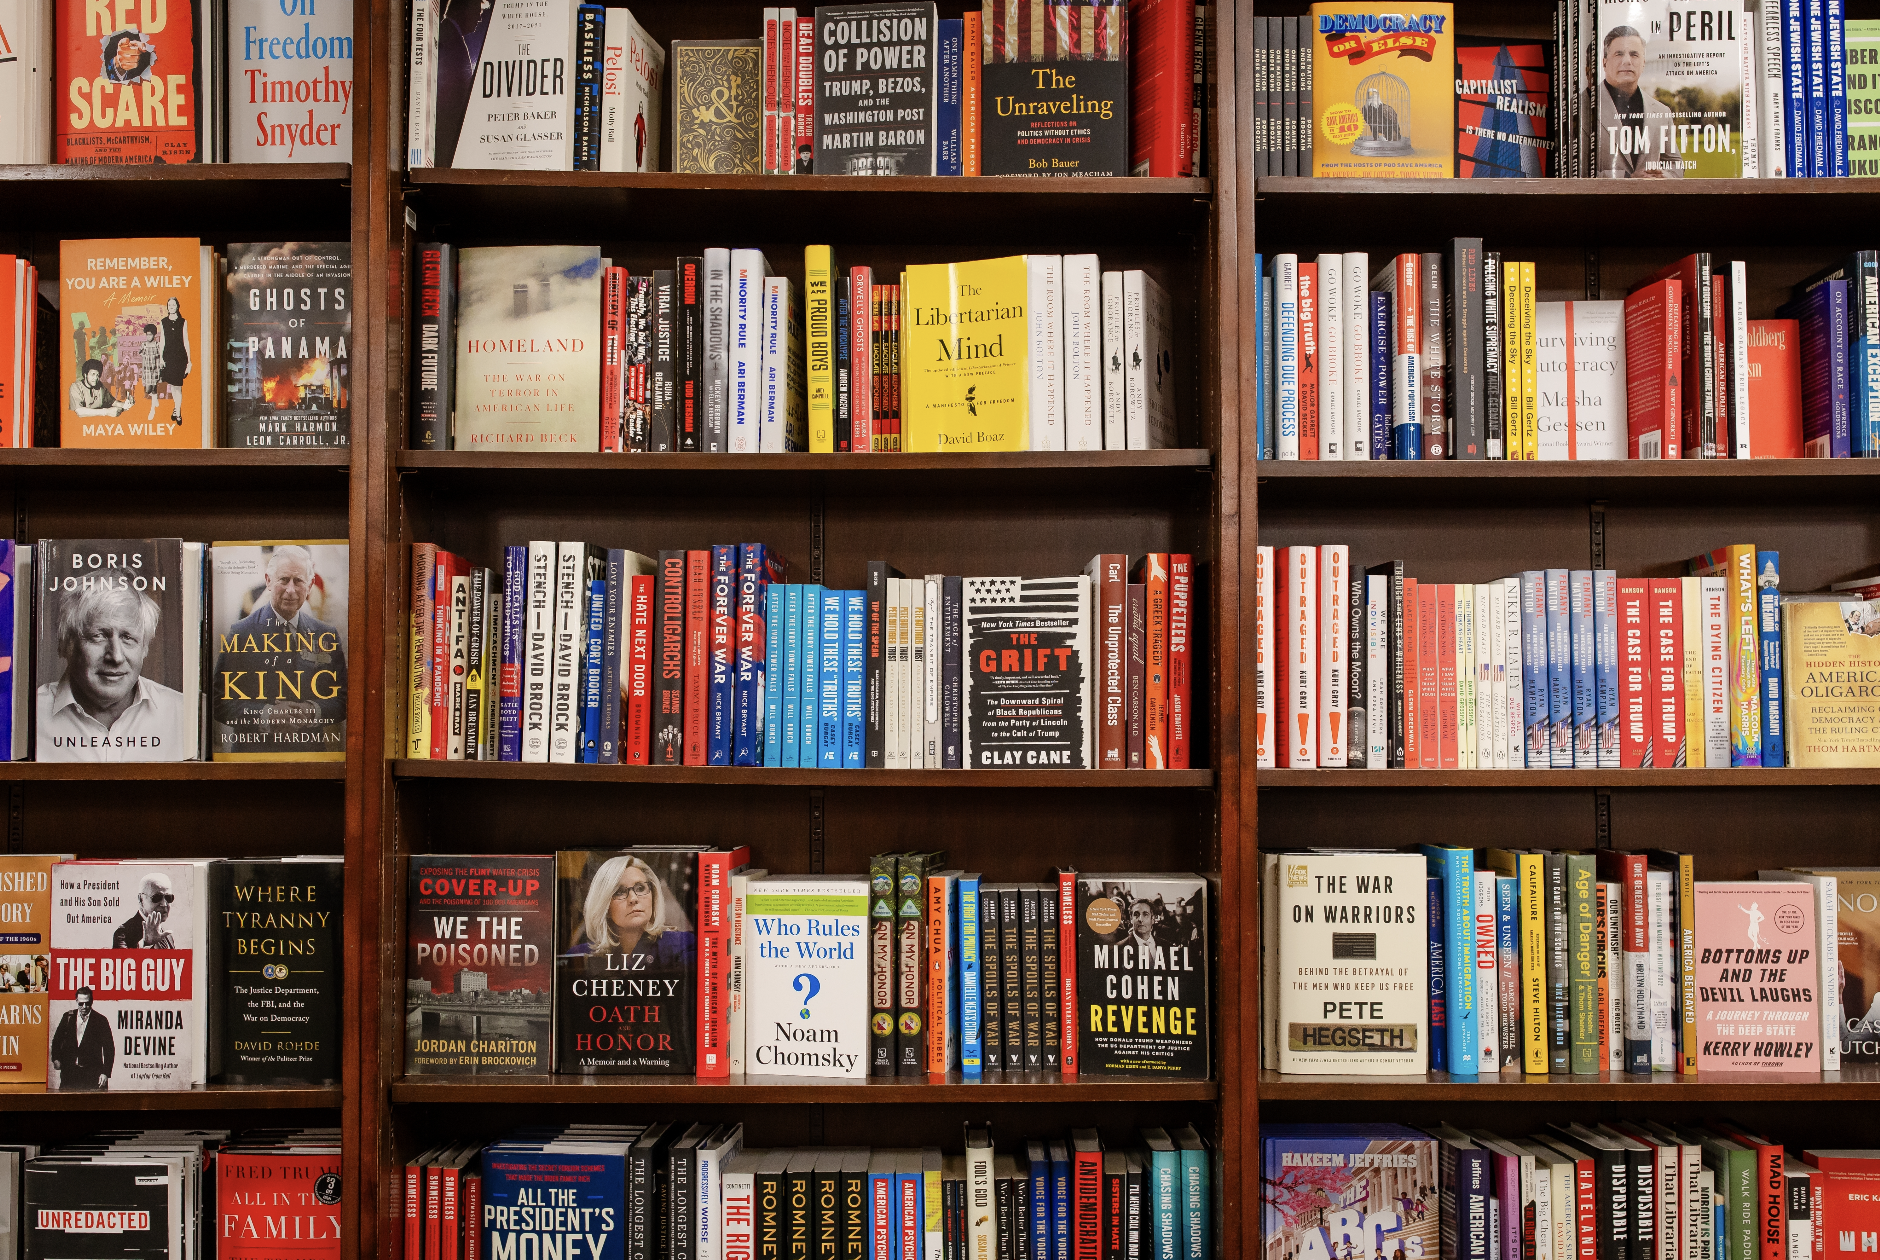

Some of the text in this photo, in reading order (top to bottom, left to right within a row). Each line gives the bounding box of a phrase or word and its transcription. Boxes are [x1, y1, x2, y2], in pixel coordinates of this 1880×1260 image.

[823, 18, 927, 45] COLLISION
[1319, 13, 1446, 34] DEMOCRACY
[1669, 10, 1736, 42] PERIL
[244, 23, 353, 60] Freedom
[518, 43, 530, 55] THE
[583, 13, 595, 79] BASELESS
[824, 45, 926, 72] OF POWER
[482, 58, 564, 98] DIVIDER
[605, 46, 622, 95] Pelosi
[1032, 68, 1076, 89] The
[245, 66, 353, 114] Timothy
[824, 77, 926, 97] TRUMP, BEZOS,
[1455, 79, 1518, 95] CAPITALIST
[69, 75, 188, 129] SCARE
[995, 95, 1113, 119] Unraveling
[1496, 96, 1546, 118] REALISM
[487, 111, 558, 122] PETER BAKER
[824, 108, 924, 125] WASHINGTON POST
[257, 110, 341, 157] Snyder
[480, 132, 564, 144] SUSAN GLASSER
[822, 129, 925, 150] MARTIN BARON
[1474, 128, 1495, 140] THERE
[1497, 132, 1506, 142] NO
[1508, 134, 1554, 150] ALTERNATIVE?
[1608, 124, 1736, 155] TOM FITTON,
[1028, 159, 1079, 169] Bob Bauer
[1645, 160, 1696, 170] JUDICIAL WATCH
[87, 256, 172, 271] REMEMBER,
[66, 275, 192, 290] YOU ARE A WILEY
[957, 284, 982, 296] The
[249, 288, 345, 311] GHOSTS
[289, 318, 305, 328] OF
[658, 285, 670, 362] VIRAL JUSTICE
[915, 302, 1023, 326] Libertarian
[249, 336, 347, 359] PANAMA
[468, 338, 584, 354] HOMELAND
[737, 269, 747, 424] MINORITY RULE ARI BERMAN
[936, 334, 1004, 361] Mind
[1282, 303, 1295, 437] DEFENDING DUE PROCESS
[475, 404, 540, 412] AMERICAN
[82, 423, 175, 437] MAYA WILEY
[259, 421, 337, 432] MARK HARMON
[938, 432, 1004, 445] David Boaz
[73, 554, 143, 568] BORIS
[49, 576, 166, 591] JOHNSON
[219, 632, 339, 653] MAKING
[634, 595, 648, 696] HATE NEXT DOOR
[1010, 634, 1037, 644] THE
[979, 648, 1072, 672] GRIFT
[1108, 604, 1121, 726] The Unprotected Class
[1627, 600, 1643, 743] THE CASE FOR TRUMP
[220, 669, 342, 700] KING
[996, 708, 1062, 716] Black Republicans
[53, 736, 161, 747] UNLEASHED
[220, 732, 340, 743] ROBERT HARDMAN
[981, 751, 1070, 765] CLAY CANE
[60, 880, 75, 890] How
[83, 879, 119, 890] President
[235, 886, 316, 903] WHERE
[1315, 876, 1393, 893] THE WAR
[223, 912, 330, 928] TYRANNY
[1293, 906, 1415, 923] ON WARRIORS
[434, 917, 523, 939] WE THE
[754, 918, 860, 937] Who Rules
[237, 938, 315, 956] BEGINS
[760, 940, 855, 960] the World
[1476, 914, 1495, 969] OWNED
[417, 944, 539, 967] POISONED
[605, 954, 646, 970] LIZ
[1094, 945, 1194, 971] MICHAEL
[1701, 949, 1809, 964] BOTTOMS UP
[57, 958, 184, 991] THE BIG GUY
[1720, 969, 1786, 982] AND THE
[235, 986, 319, 996] The Justice Department,
[572, 980, 679, 996] CHENEY
[1107, 975, 1179, 1000] COHEN
[1700, 988, 1813, 1003] DEVIL LAUGHS
[118, 1010, 183, 1030] MIRANDA
[589, 1006, 660, 1022] OATH
[1091, 1005, 1197, 1035] REVENGE
[1323, 1002, 1383, 1020] PETE
[576, 1034, 674, 1051] HONOR
[774, 1022, 840, 1043] Noam
[1302, 1027, 1404, 1046] HEGSETH
[124, 1036, 175, 1056] DEVINE
[414, 1040, 536, 1053] JORDAN CHARITON
[1703, 1041, 1813, 1058] KERRY HOWLEY
[756, 1045, 859, 1072] Chomsky
[1282, 1154, 1417, 1168] HAKEEM JEFFRIES
[1766, 1154, 1781, 1244] MAD HOUSE
[40, 1212, 148, 1229] UNREDACTED
[485, 1206, 614, 1232] PRESIDENT'S
[1161, 1168, 1173, 1259] CHASING SHADOWS
[1580, 1170, 1593, 1256] HATELAND
